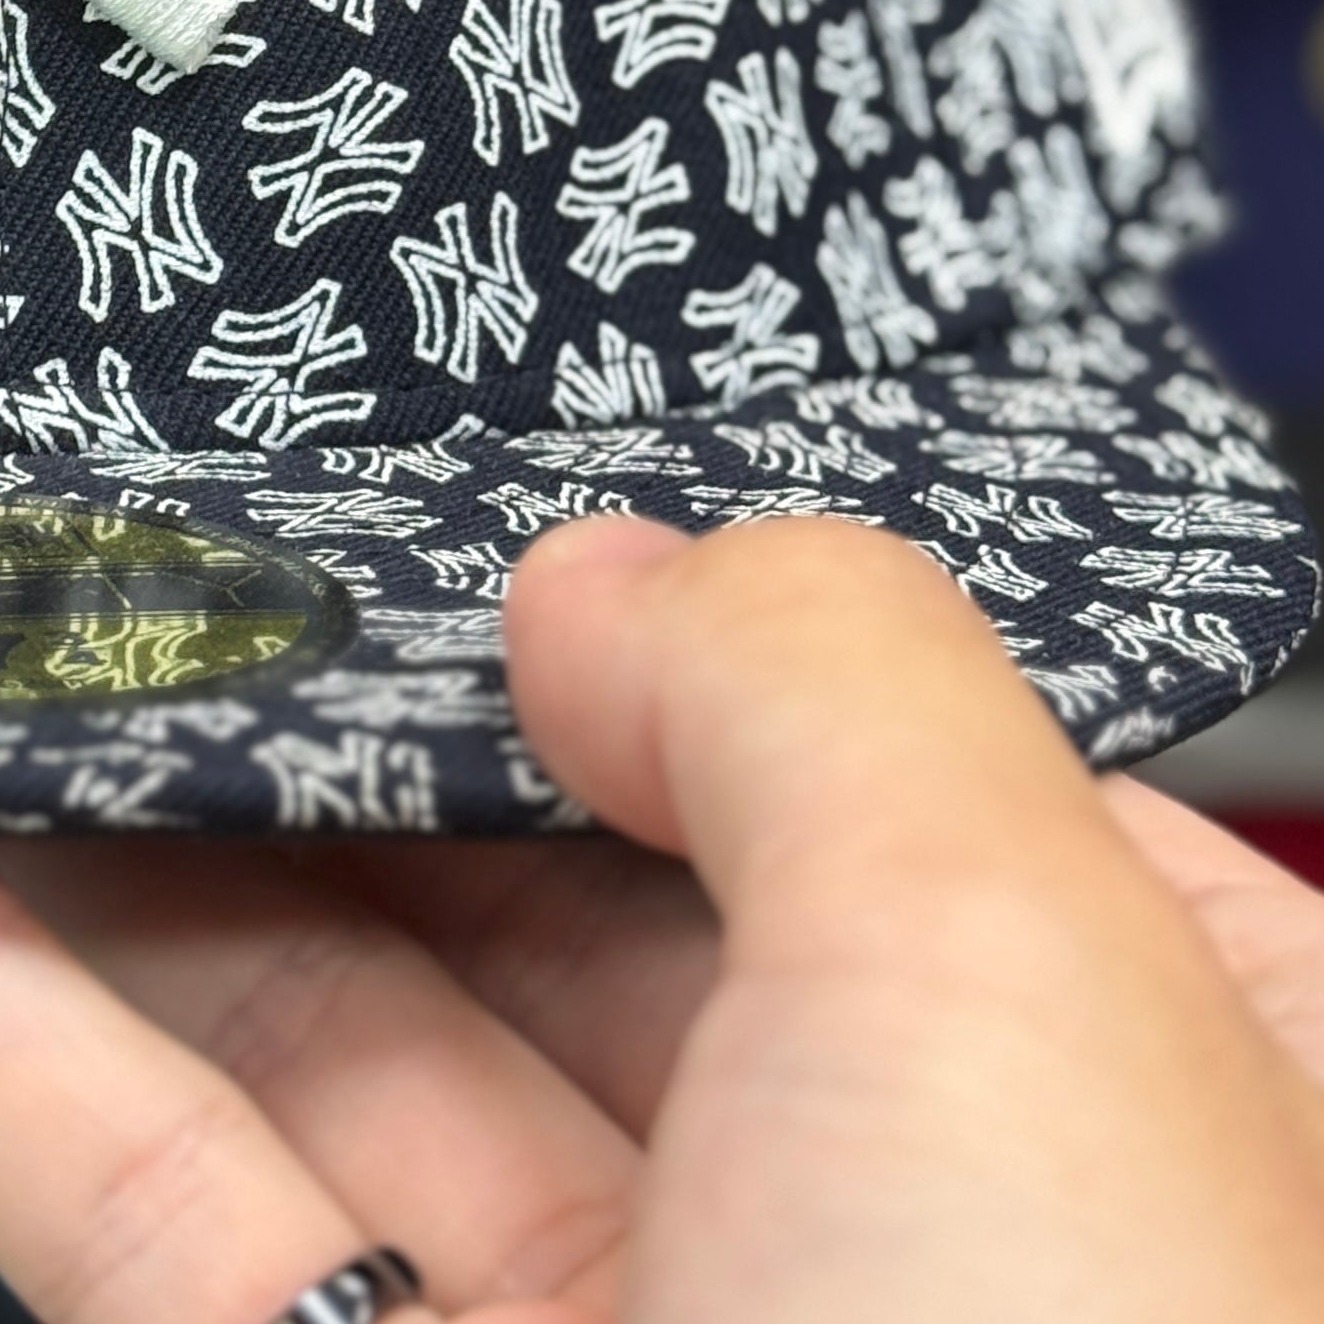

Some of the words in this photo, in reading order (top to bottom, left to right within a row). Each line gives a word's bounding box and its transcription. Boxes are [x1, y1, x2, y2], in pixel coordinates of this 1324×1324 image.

[56, 126, 224, 322] NY
[242, 67, 425, 248] NY
[556, 118, 695, 293] NY
[187, 279, 378, 452] NY
[390, 191, 538, 383] NY
